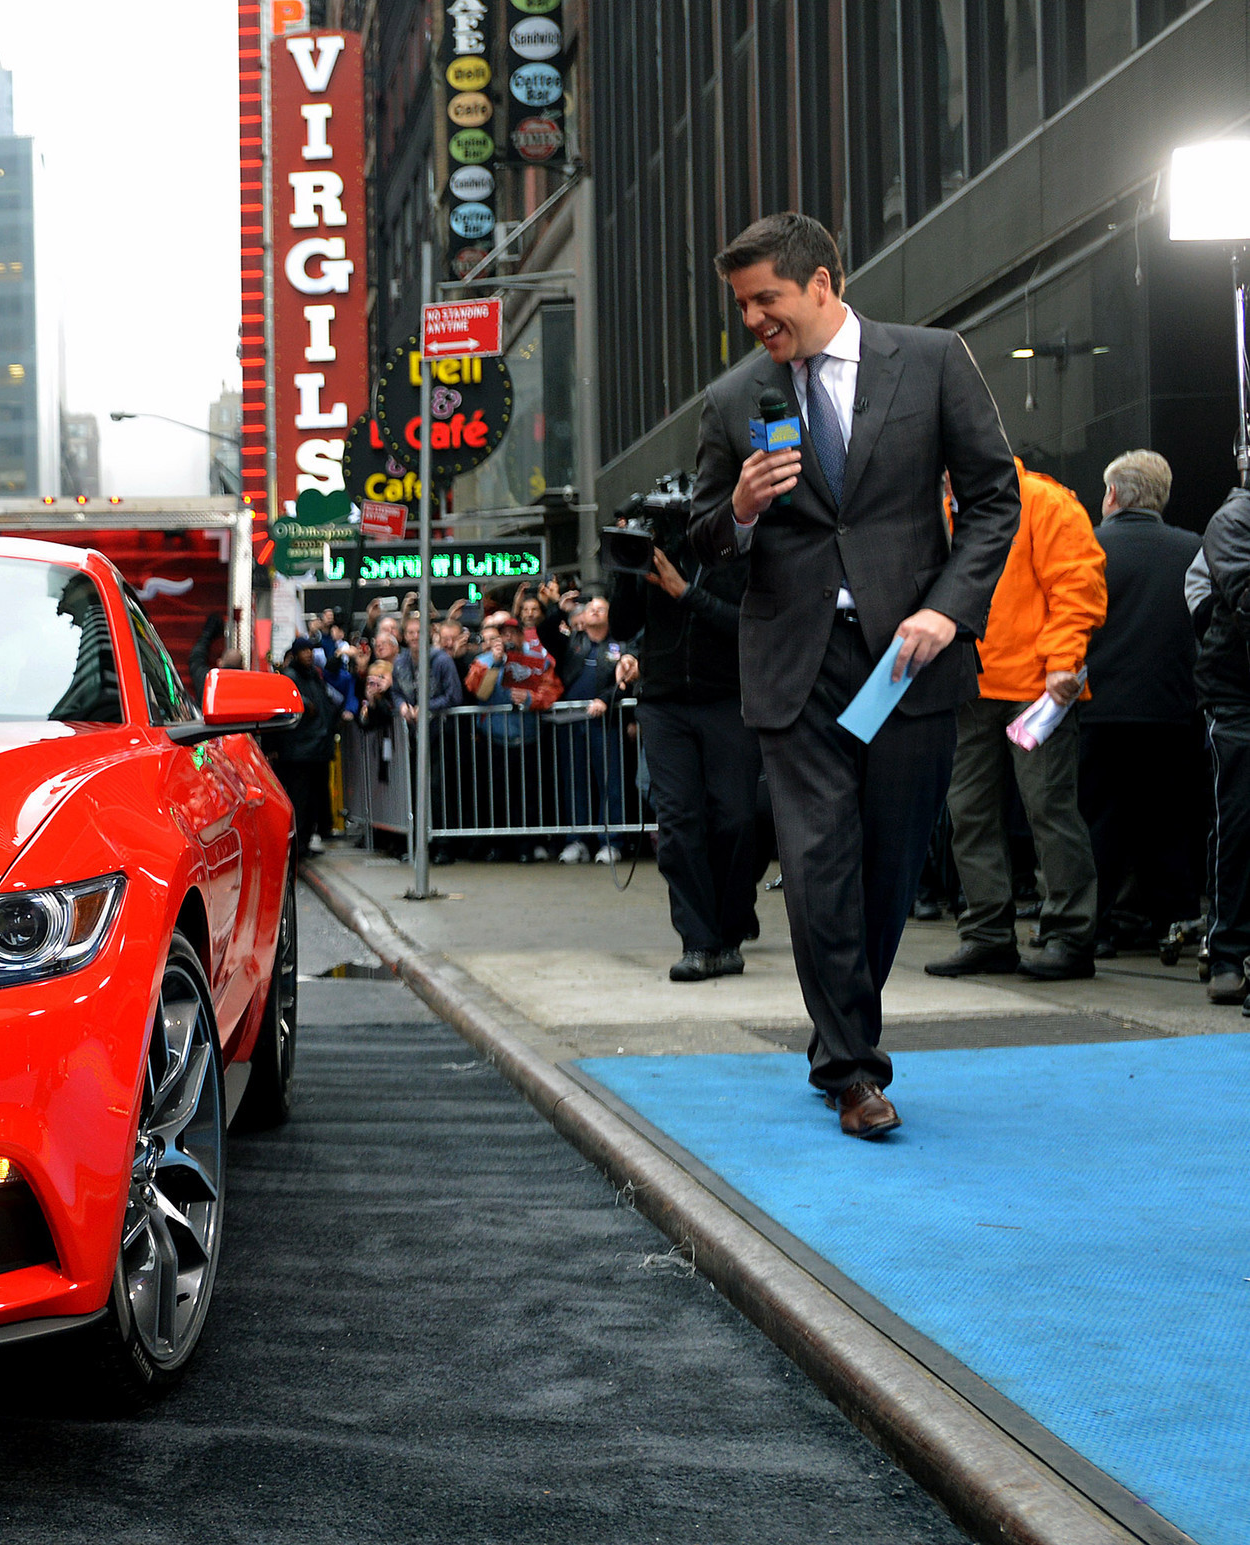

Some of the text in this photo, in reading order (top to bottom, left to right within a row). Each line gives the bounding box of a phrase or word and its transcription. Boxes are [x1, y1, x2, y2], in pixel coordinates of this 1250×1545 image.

[426, 304, 489, 322] NO STANDING
[426, 319, 470, 335] ANYTIME
[409, 351, 482, 386] Deli
[404, 409, 489, 449] Café
